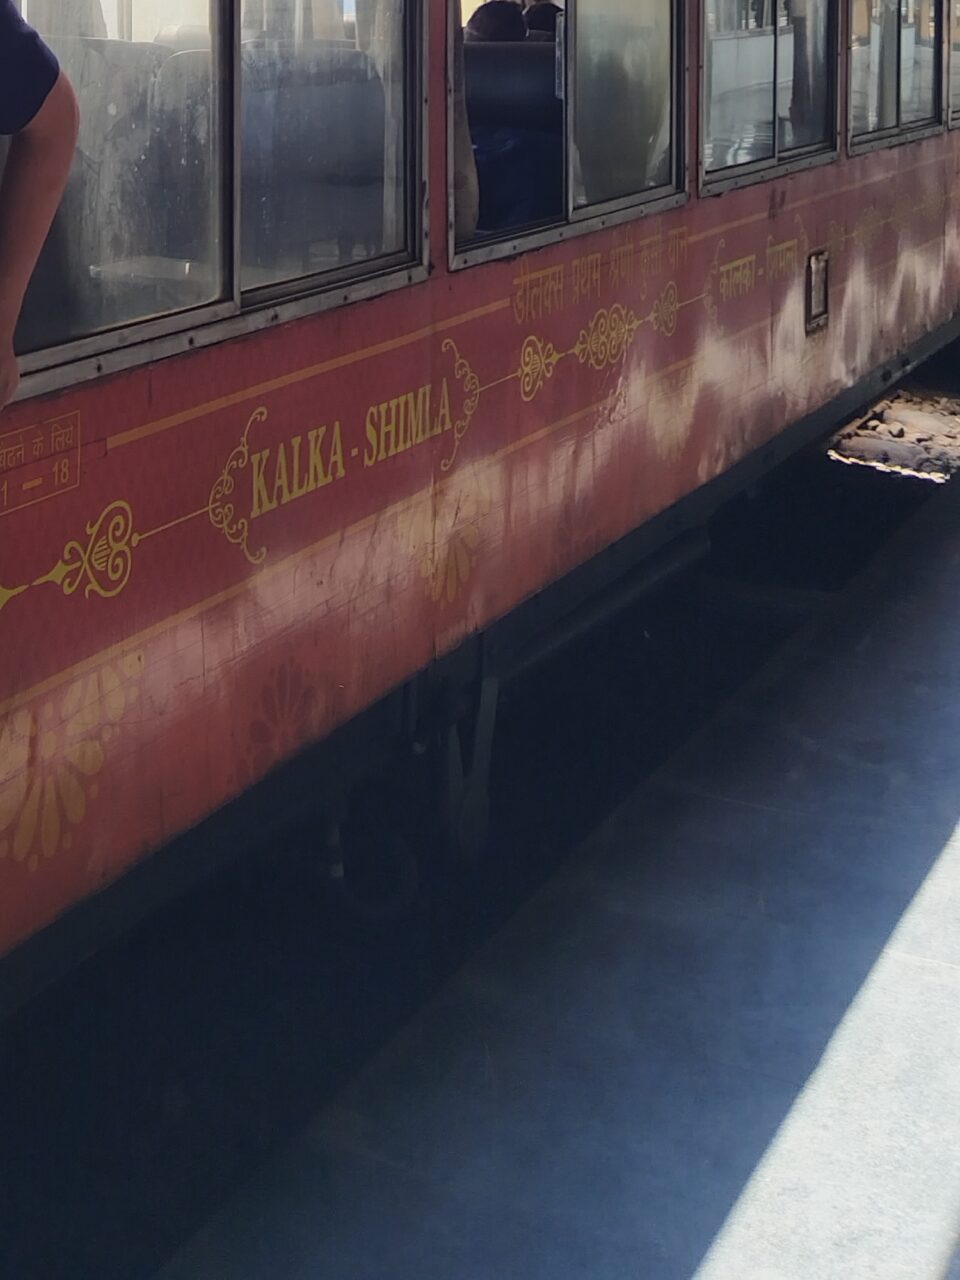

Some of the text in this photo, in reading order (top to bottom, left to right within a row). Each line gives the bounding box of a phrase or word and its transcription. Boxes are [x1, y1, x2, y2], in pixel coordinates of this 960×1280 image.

[0, 479, 8, 507] 1
[52, 458, 69, 486] 18
[250, 420, 346, 519] KALKA
[364, 377, 453, 468] SHIMLA
